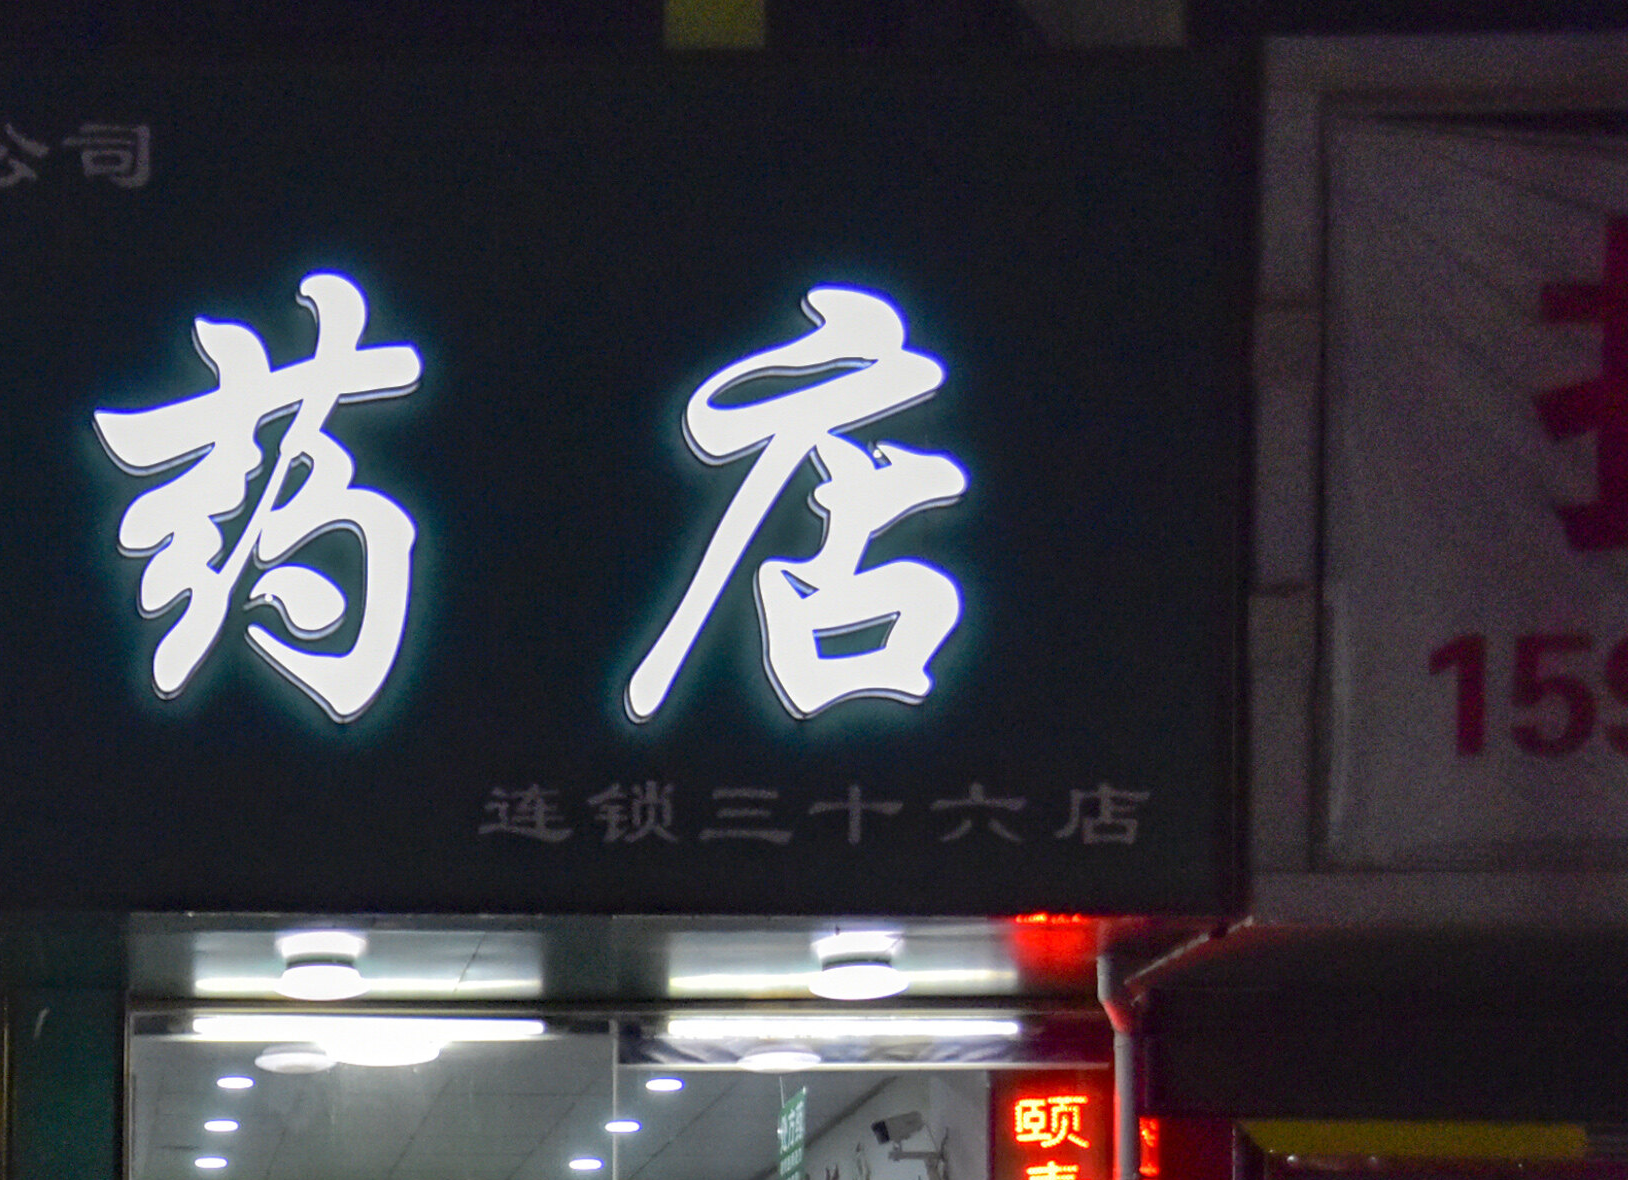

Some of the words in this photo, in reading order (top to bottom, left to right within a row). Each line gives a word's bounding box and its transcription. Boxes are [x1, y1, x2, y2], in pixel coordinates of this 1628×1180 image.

[478, 779, 1151, 846] 连锁三十六店
